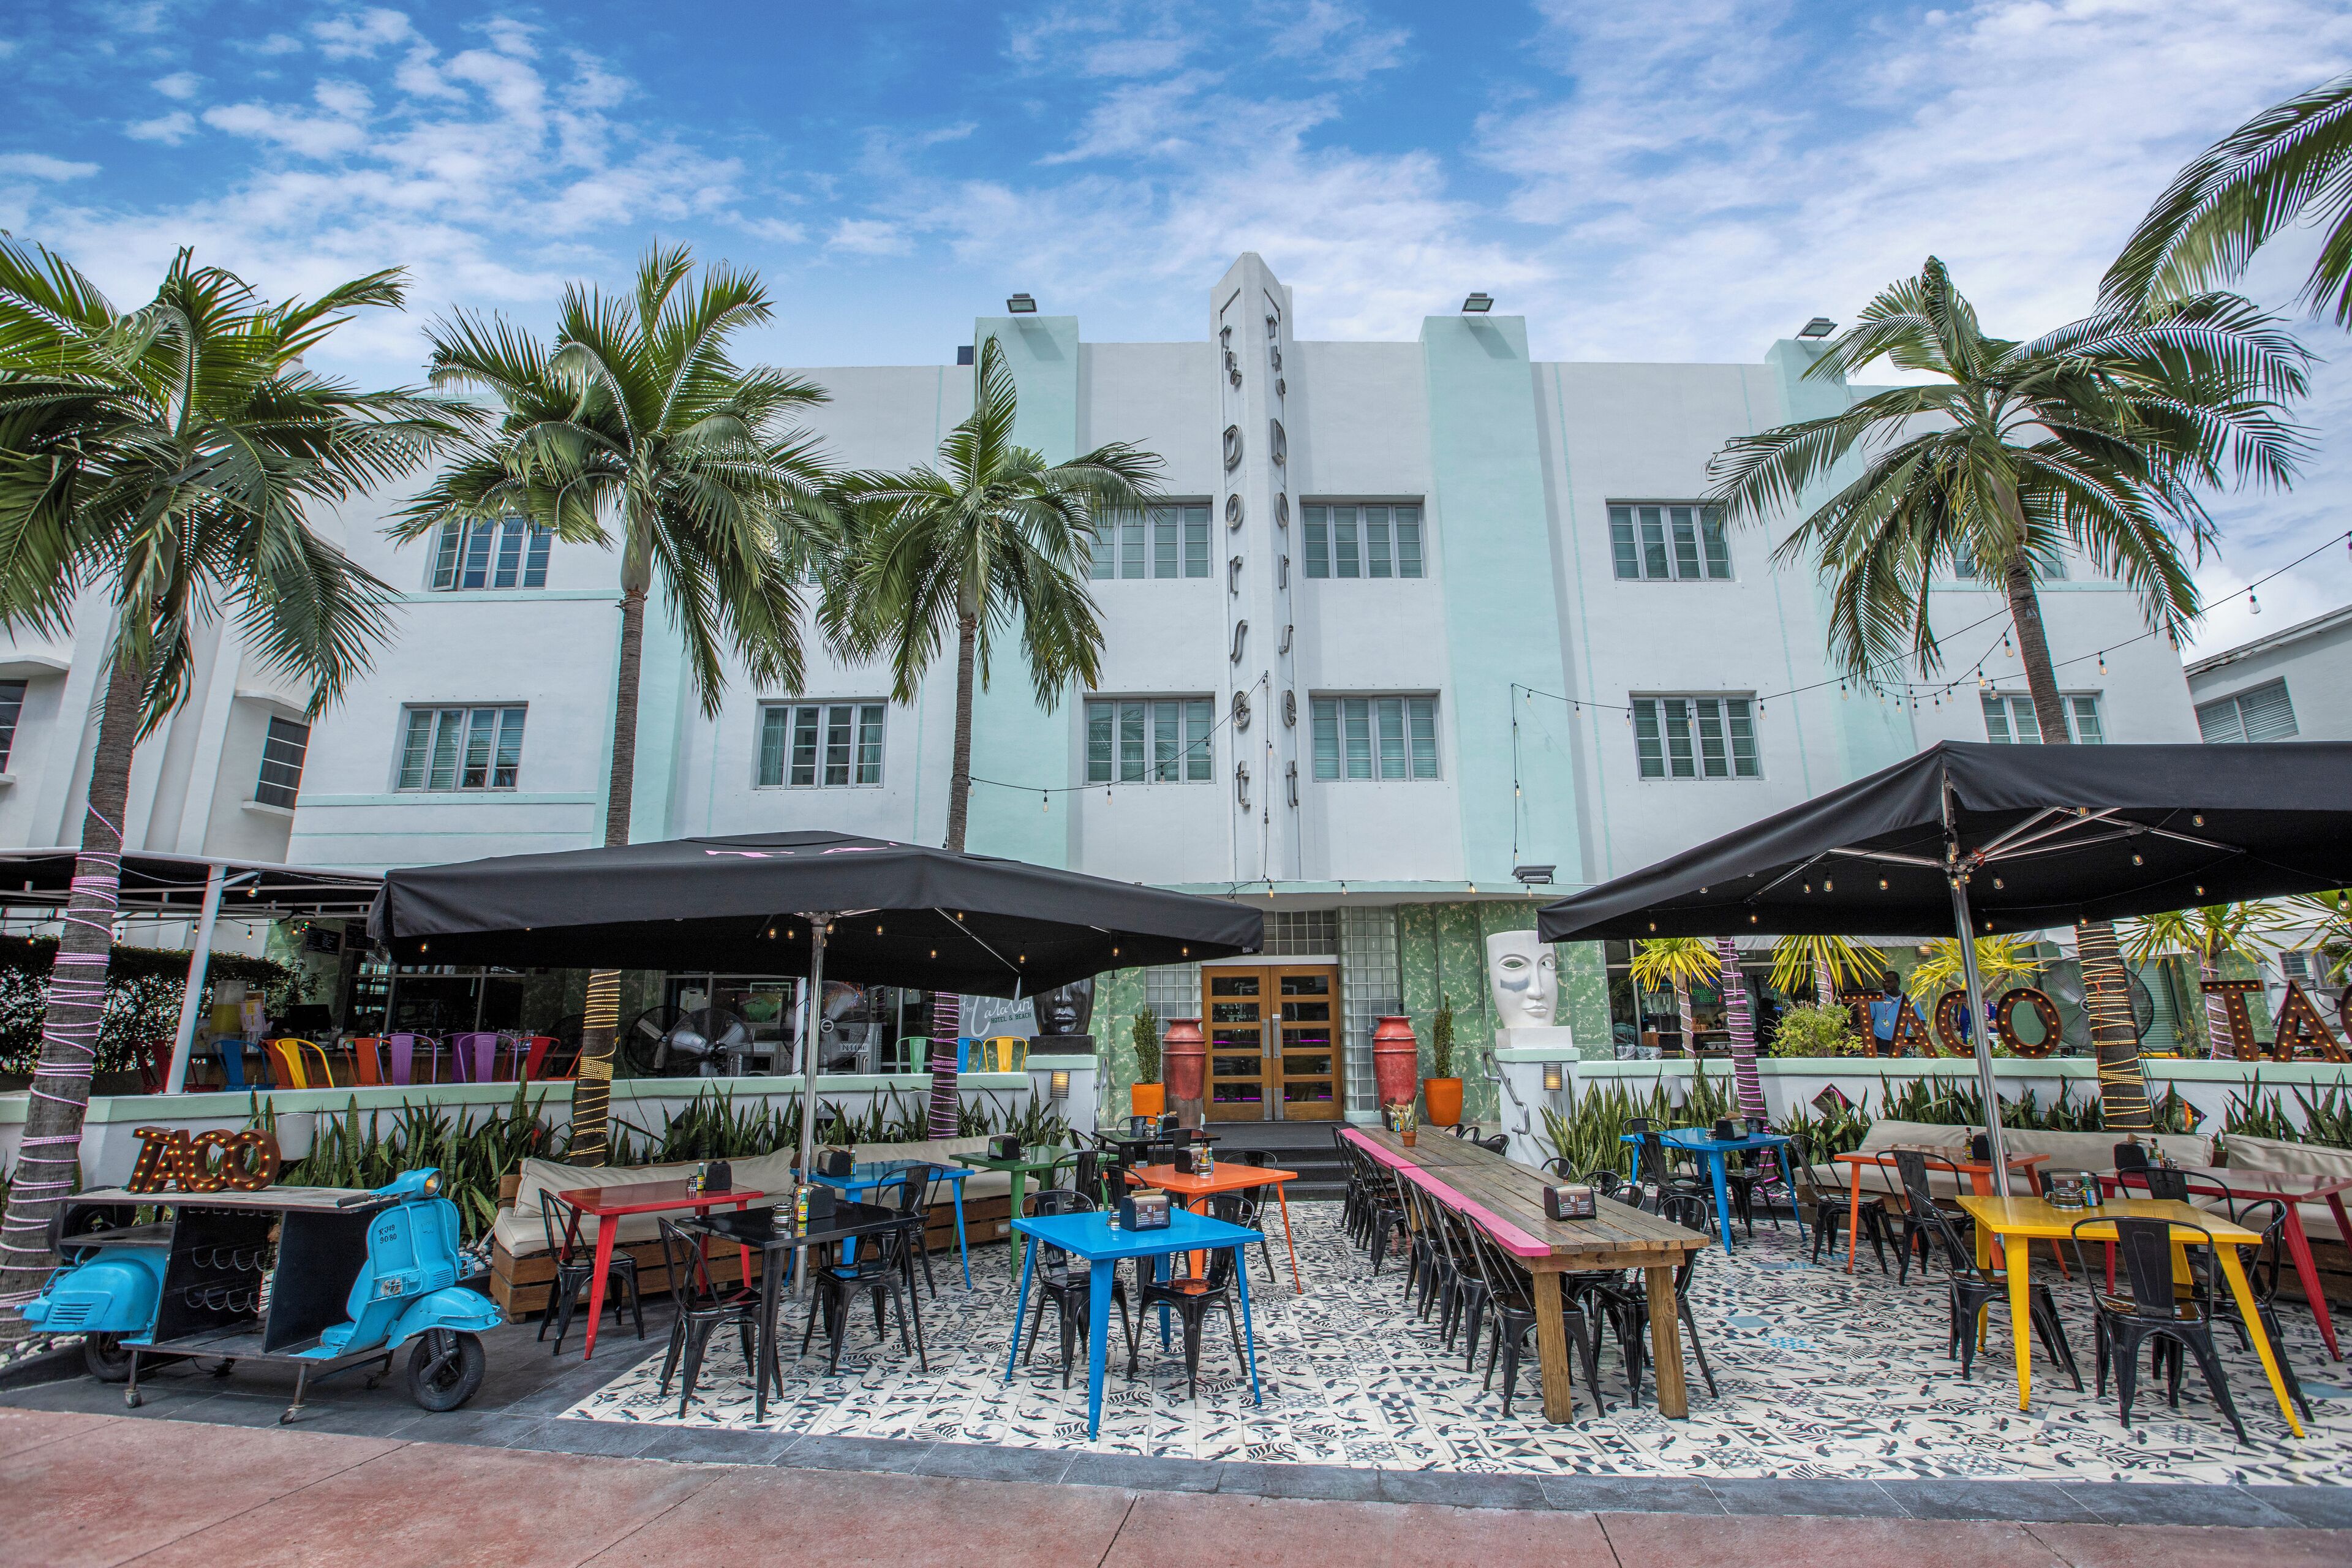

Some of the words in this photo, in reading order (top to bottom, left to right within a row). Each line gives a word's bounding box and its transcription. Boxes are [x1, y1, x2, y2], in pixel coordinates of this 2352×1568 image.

[1219, 325, 1242, 387] The
[1266, 314, 1286, 396] The
[1223, 424, 1251, 807] Dorset
[1270, 418, 1298, 807] Dorset
[971, 996, 1034, 1037] Catalin
[1841, 987, 2063, 1059] TACO
[126, 1125, 282, 1194] TACO
